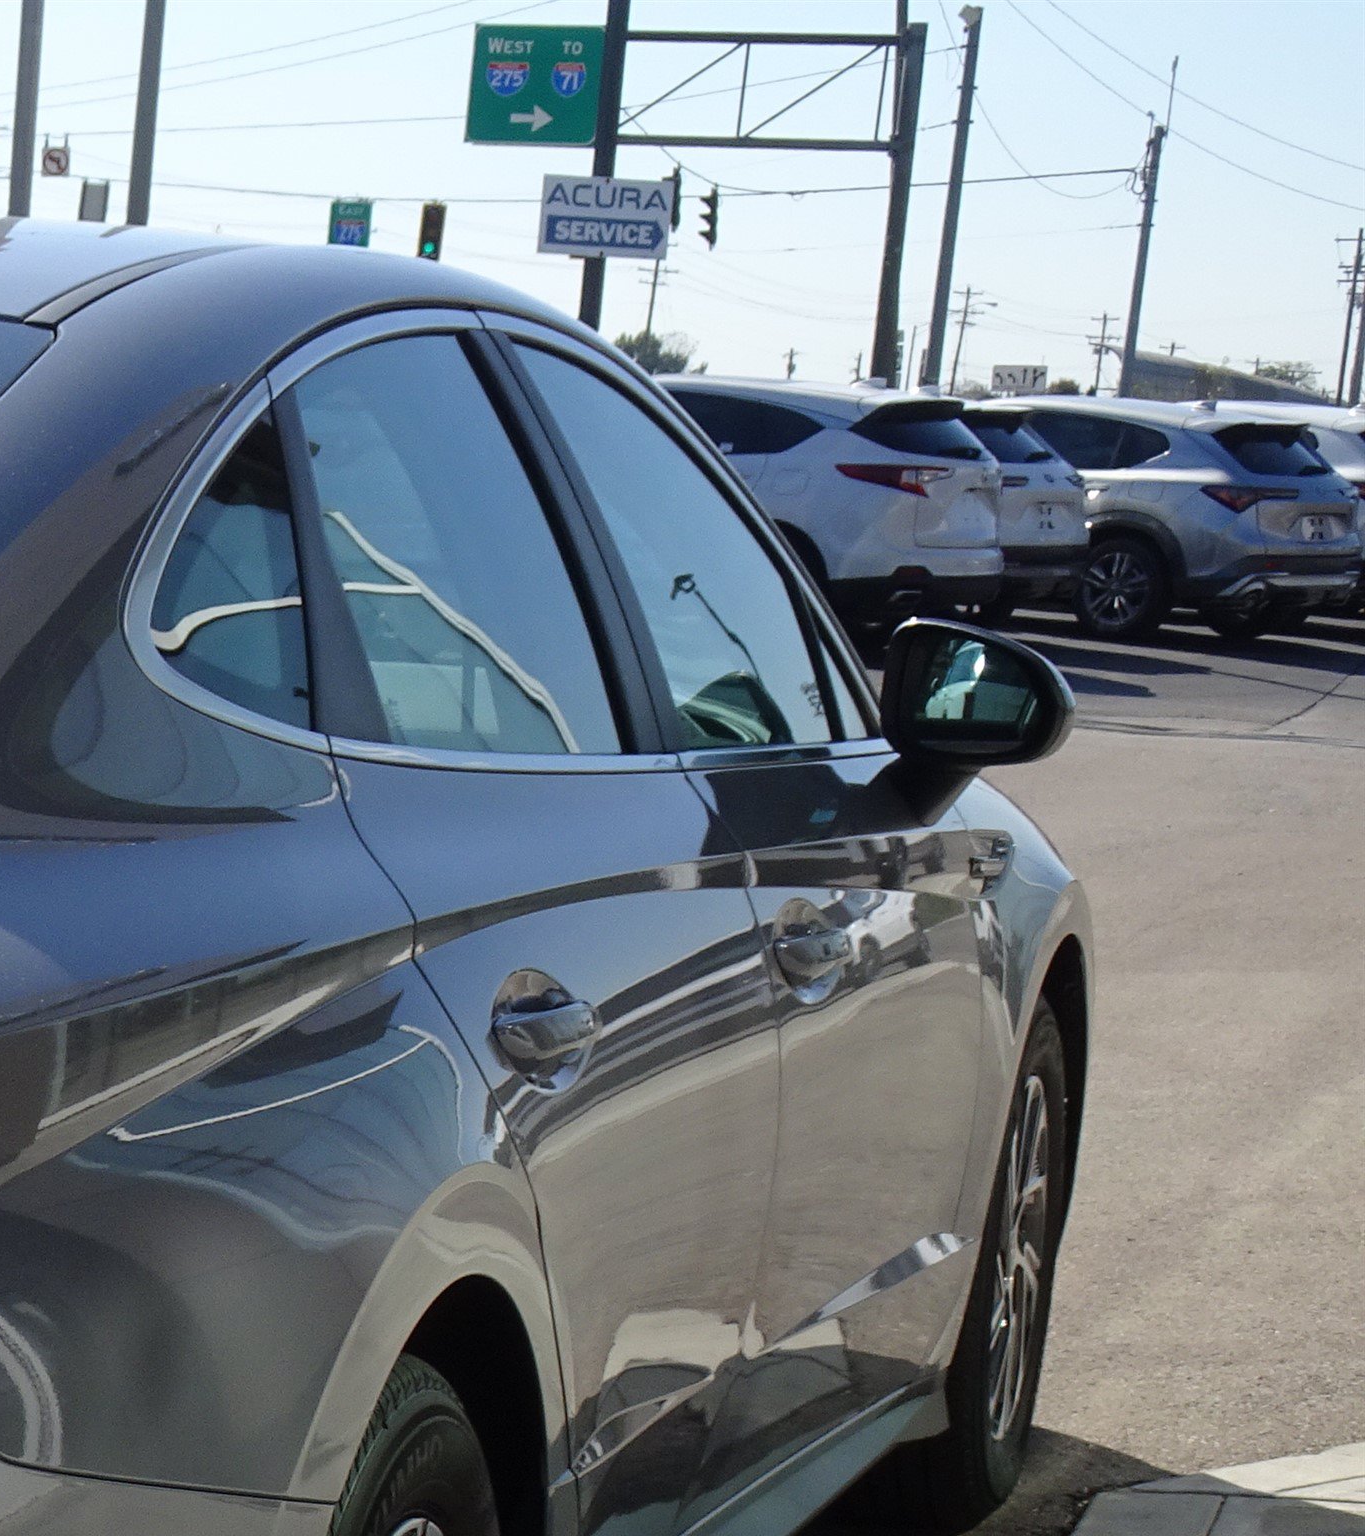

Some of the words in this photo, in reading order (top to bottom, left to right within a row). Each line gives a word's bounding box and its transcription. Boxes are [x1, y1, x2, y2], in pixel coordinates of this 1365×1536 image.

[487, 37, 535, 55] WEST
[562, 41, 584, 56] TO
[490, 70, 524, 88] 275
[560, 71, 580, 91] 71
[546, 182, 668, 212] ACURA
[554, 220, 654, 247] SERVICE
